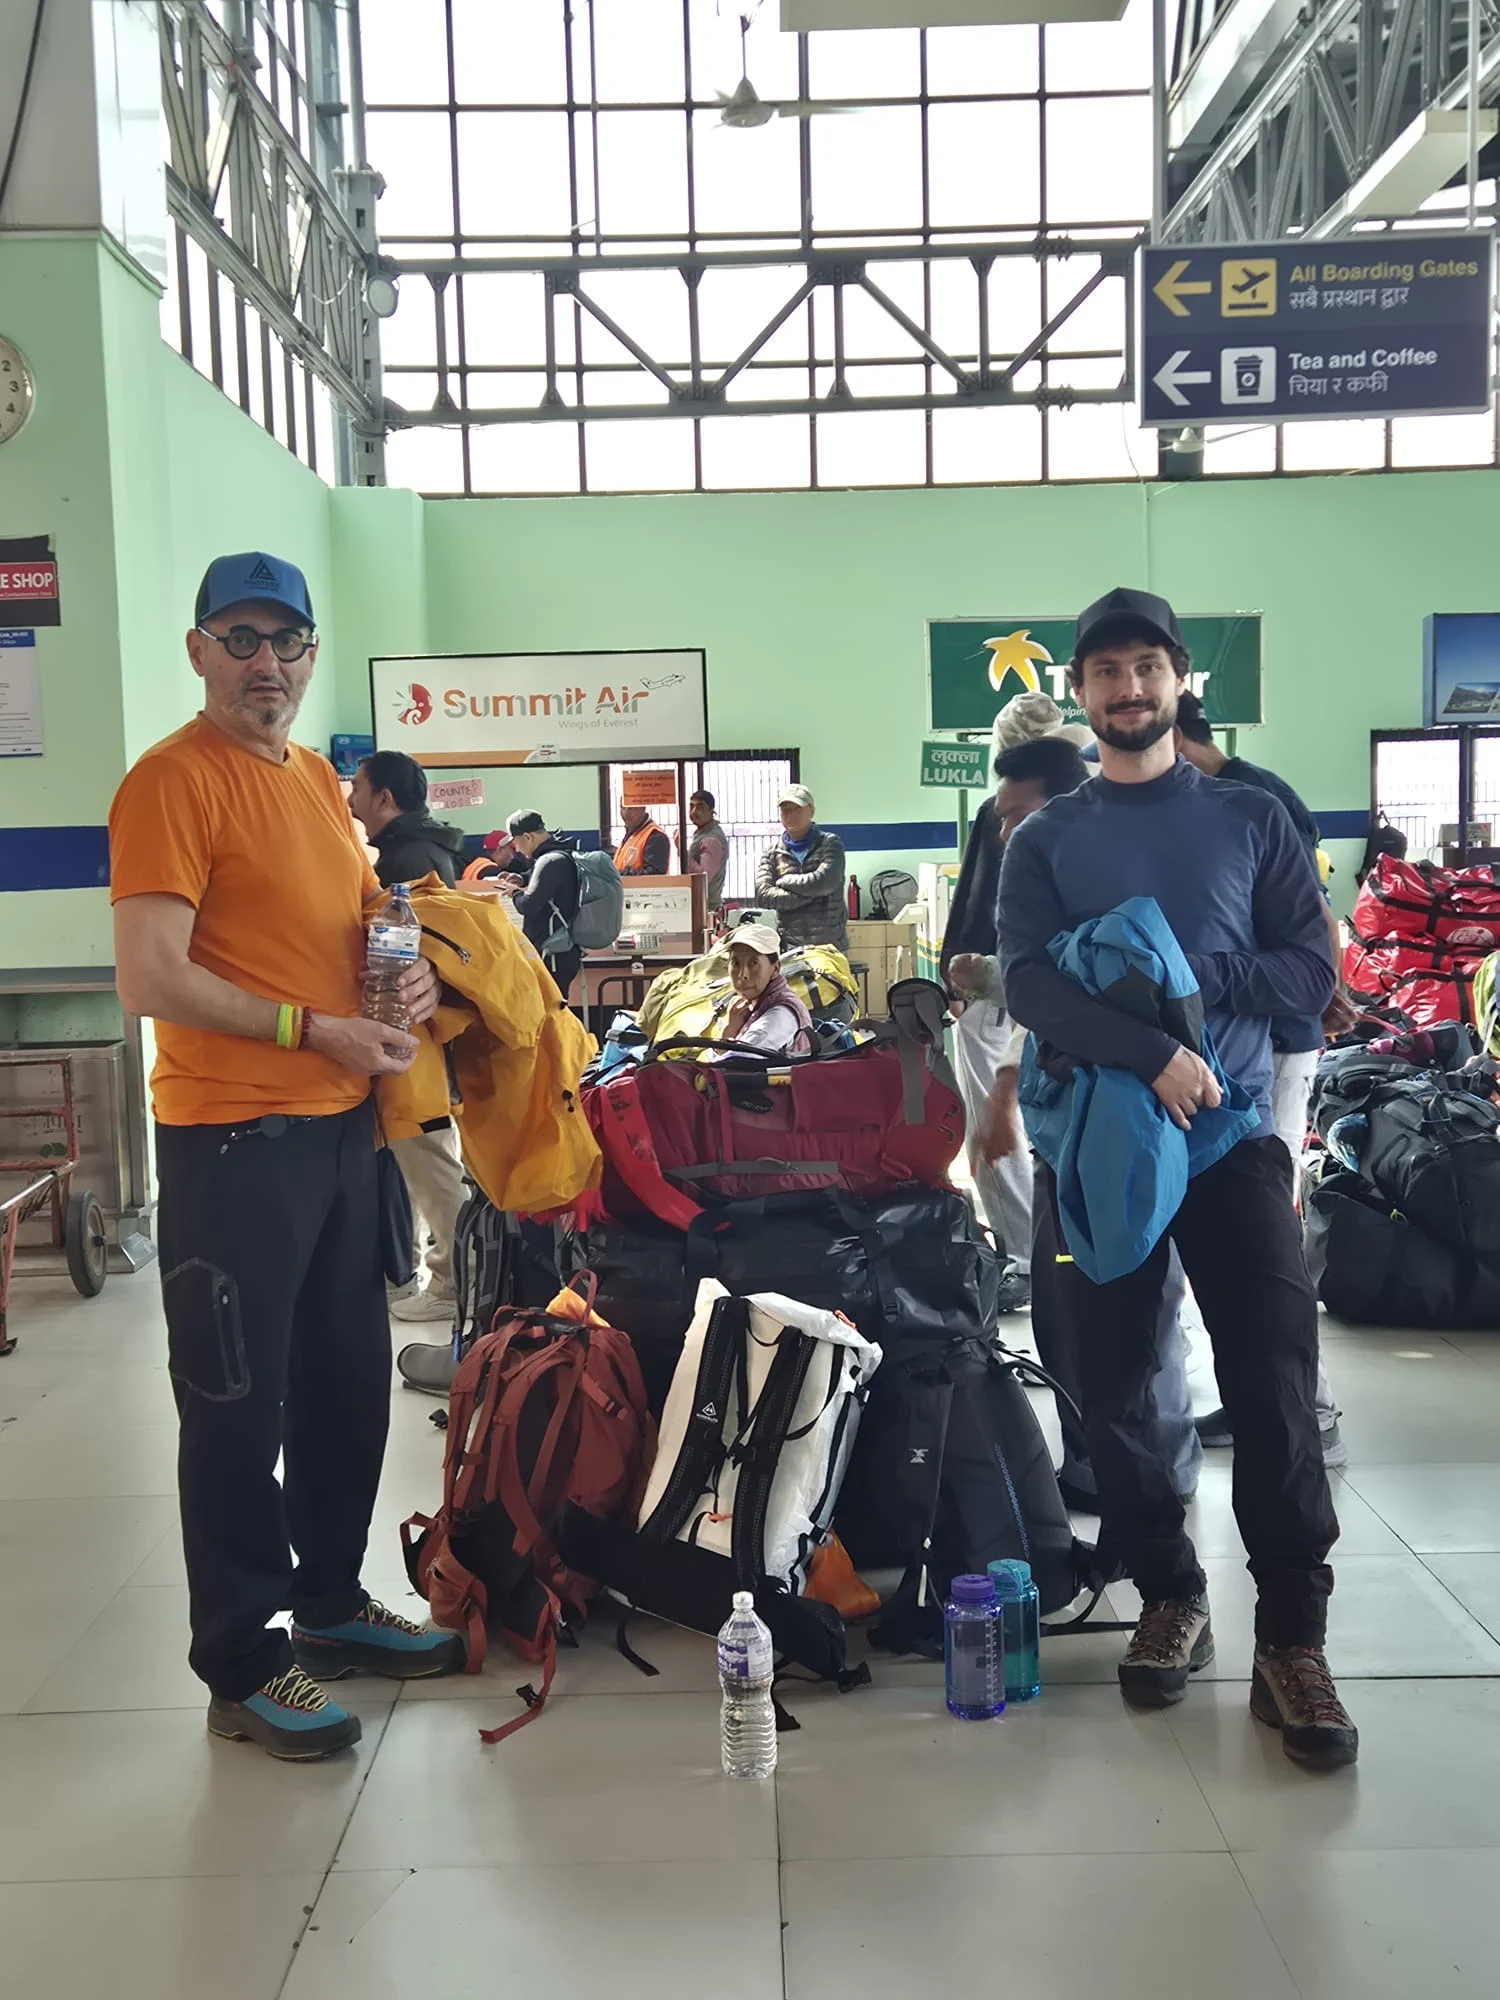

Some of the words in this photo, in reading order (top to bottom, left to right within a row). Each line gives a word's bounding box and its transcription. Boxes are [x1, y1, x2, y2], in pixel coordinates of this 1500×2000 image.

[1289, 265, 1316, 283] All
[1322, 262, 1414, 283] Boarding
[1420, 259, 1479, 278] Gates
[1289, 285, 1320, 309] सबै
[1322, 288, 1377, 308] प्रस्थान
[1, 360, 11, 372] 2
[1288, 353, 1323, 370] Tea
[1328, 350, 1366, 369] and
[1371, 347, 1438, 367] Coffee
[9, 380, 19, 393] 3
[1288, 374, 1328, 396] चिया
[1331, 377, 1344, 394] र
[1346, 370, 1389, 393] कफी
[5, 402, 15, 414] 4
[12, 572, 53, 588] SHOP
[443, 687, 587, 718] Summit
[595, 686, 649, 714] Air
[558, 719, 589, 731] Wings
[591, 719, 601, 728] of
[603, 718, 638, 728] Everest
[923, 767, 985, 785] LUKLA
